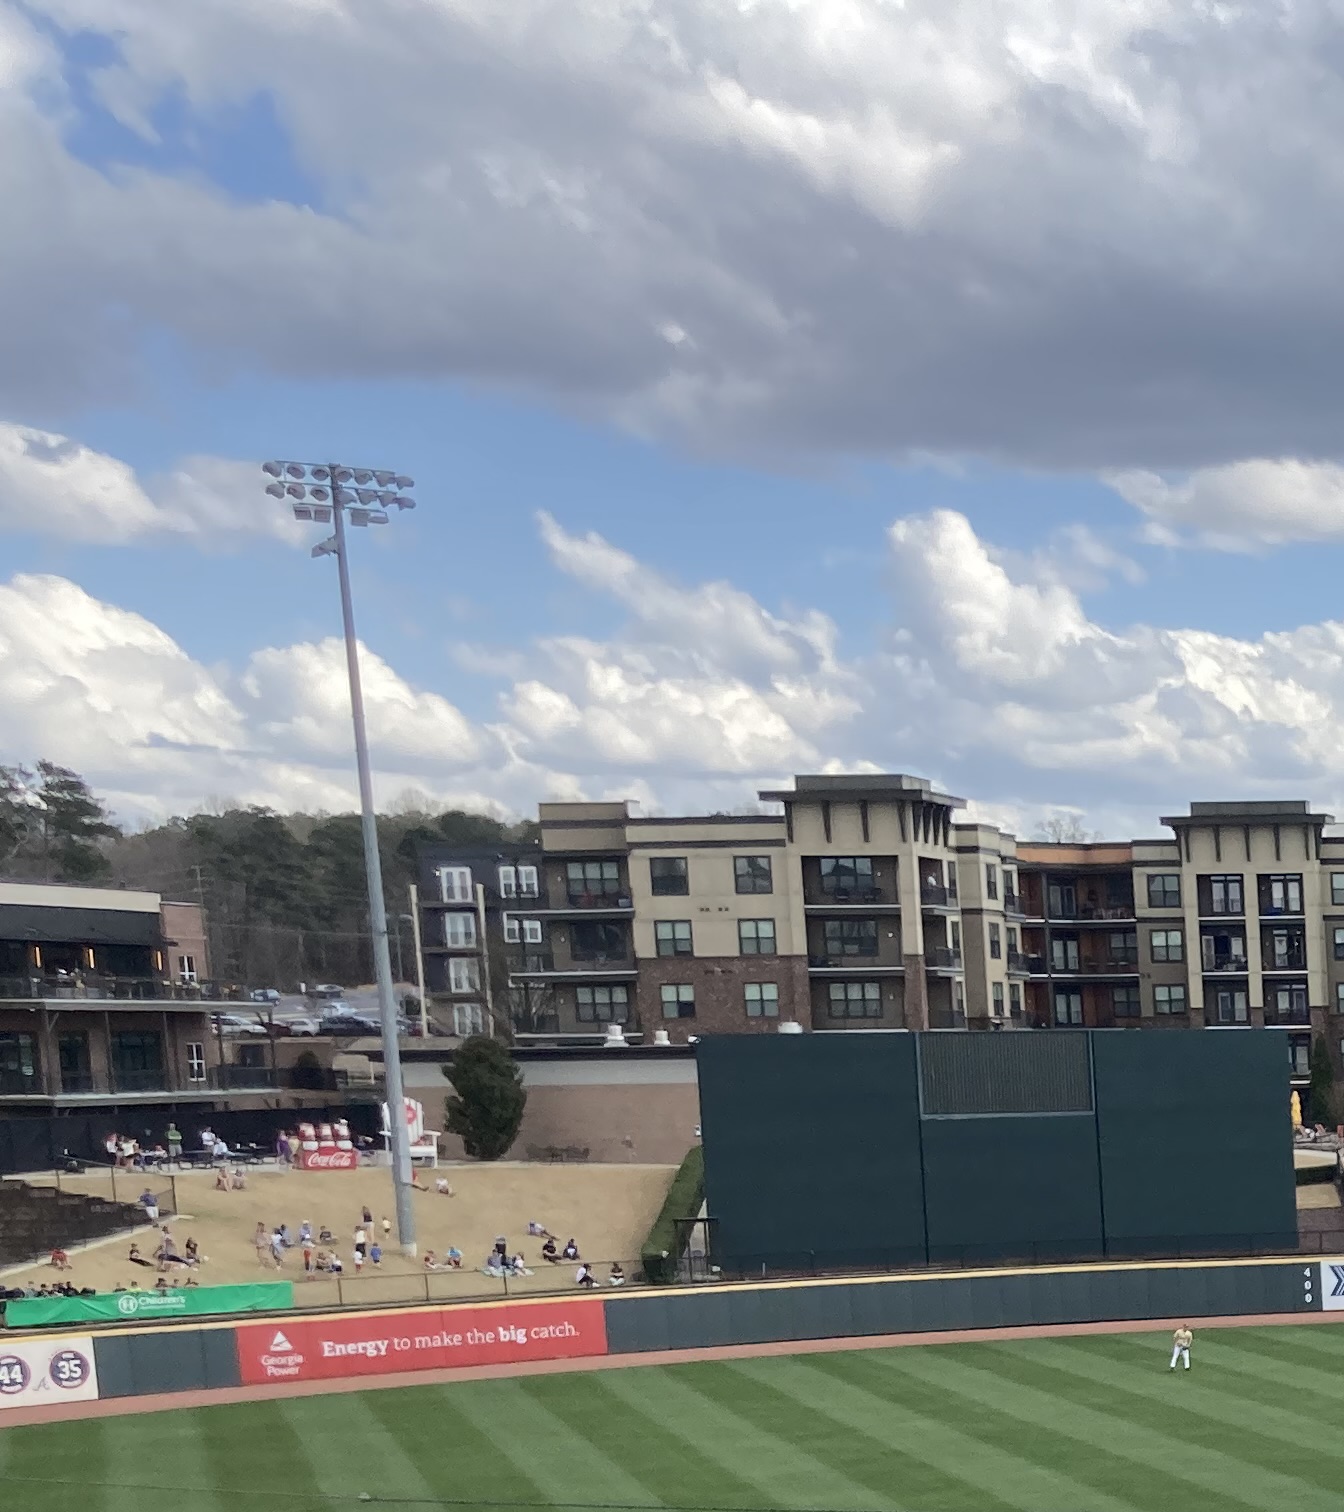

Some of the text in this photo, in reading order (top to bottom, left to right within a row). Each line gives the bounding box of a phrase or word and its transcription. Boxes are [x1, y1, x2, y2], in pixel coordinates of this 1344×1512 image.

[308, 1152, 351, 1167] Coca-Cola
[1303, 1267, 1312, 1303] 400
[139, 1296, 185, 1305] Children's
[322, 1340, 389, 1357] Energy
[394, 1337, 410, 1350] to
[415, 1332, 462, 1348] make
[467, 1328, 495, 1344] the
[499, 1325, 527, 1343] big
[261, 1353, 303, 1366] Georgia
[57, 1359, 82, 1379] 35
[266, 1366, 301, 1377] Power
